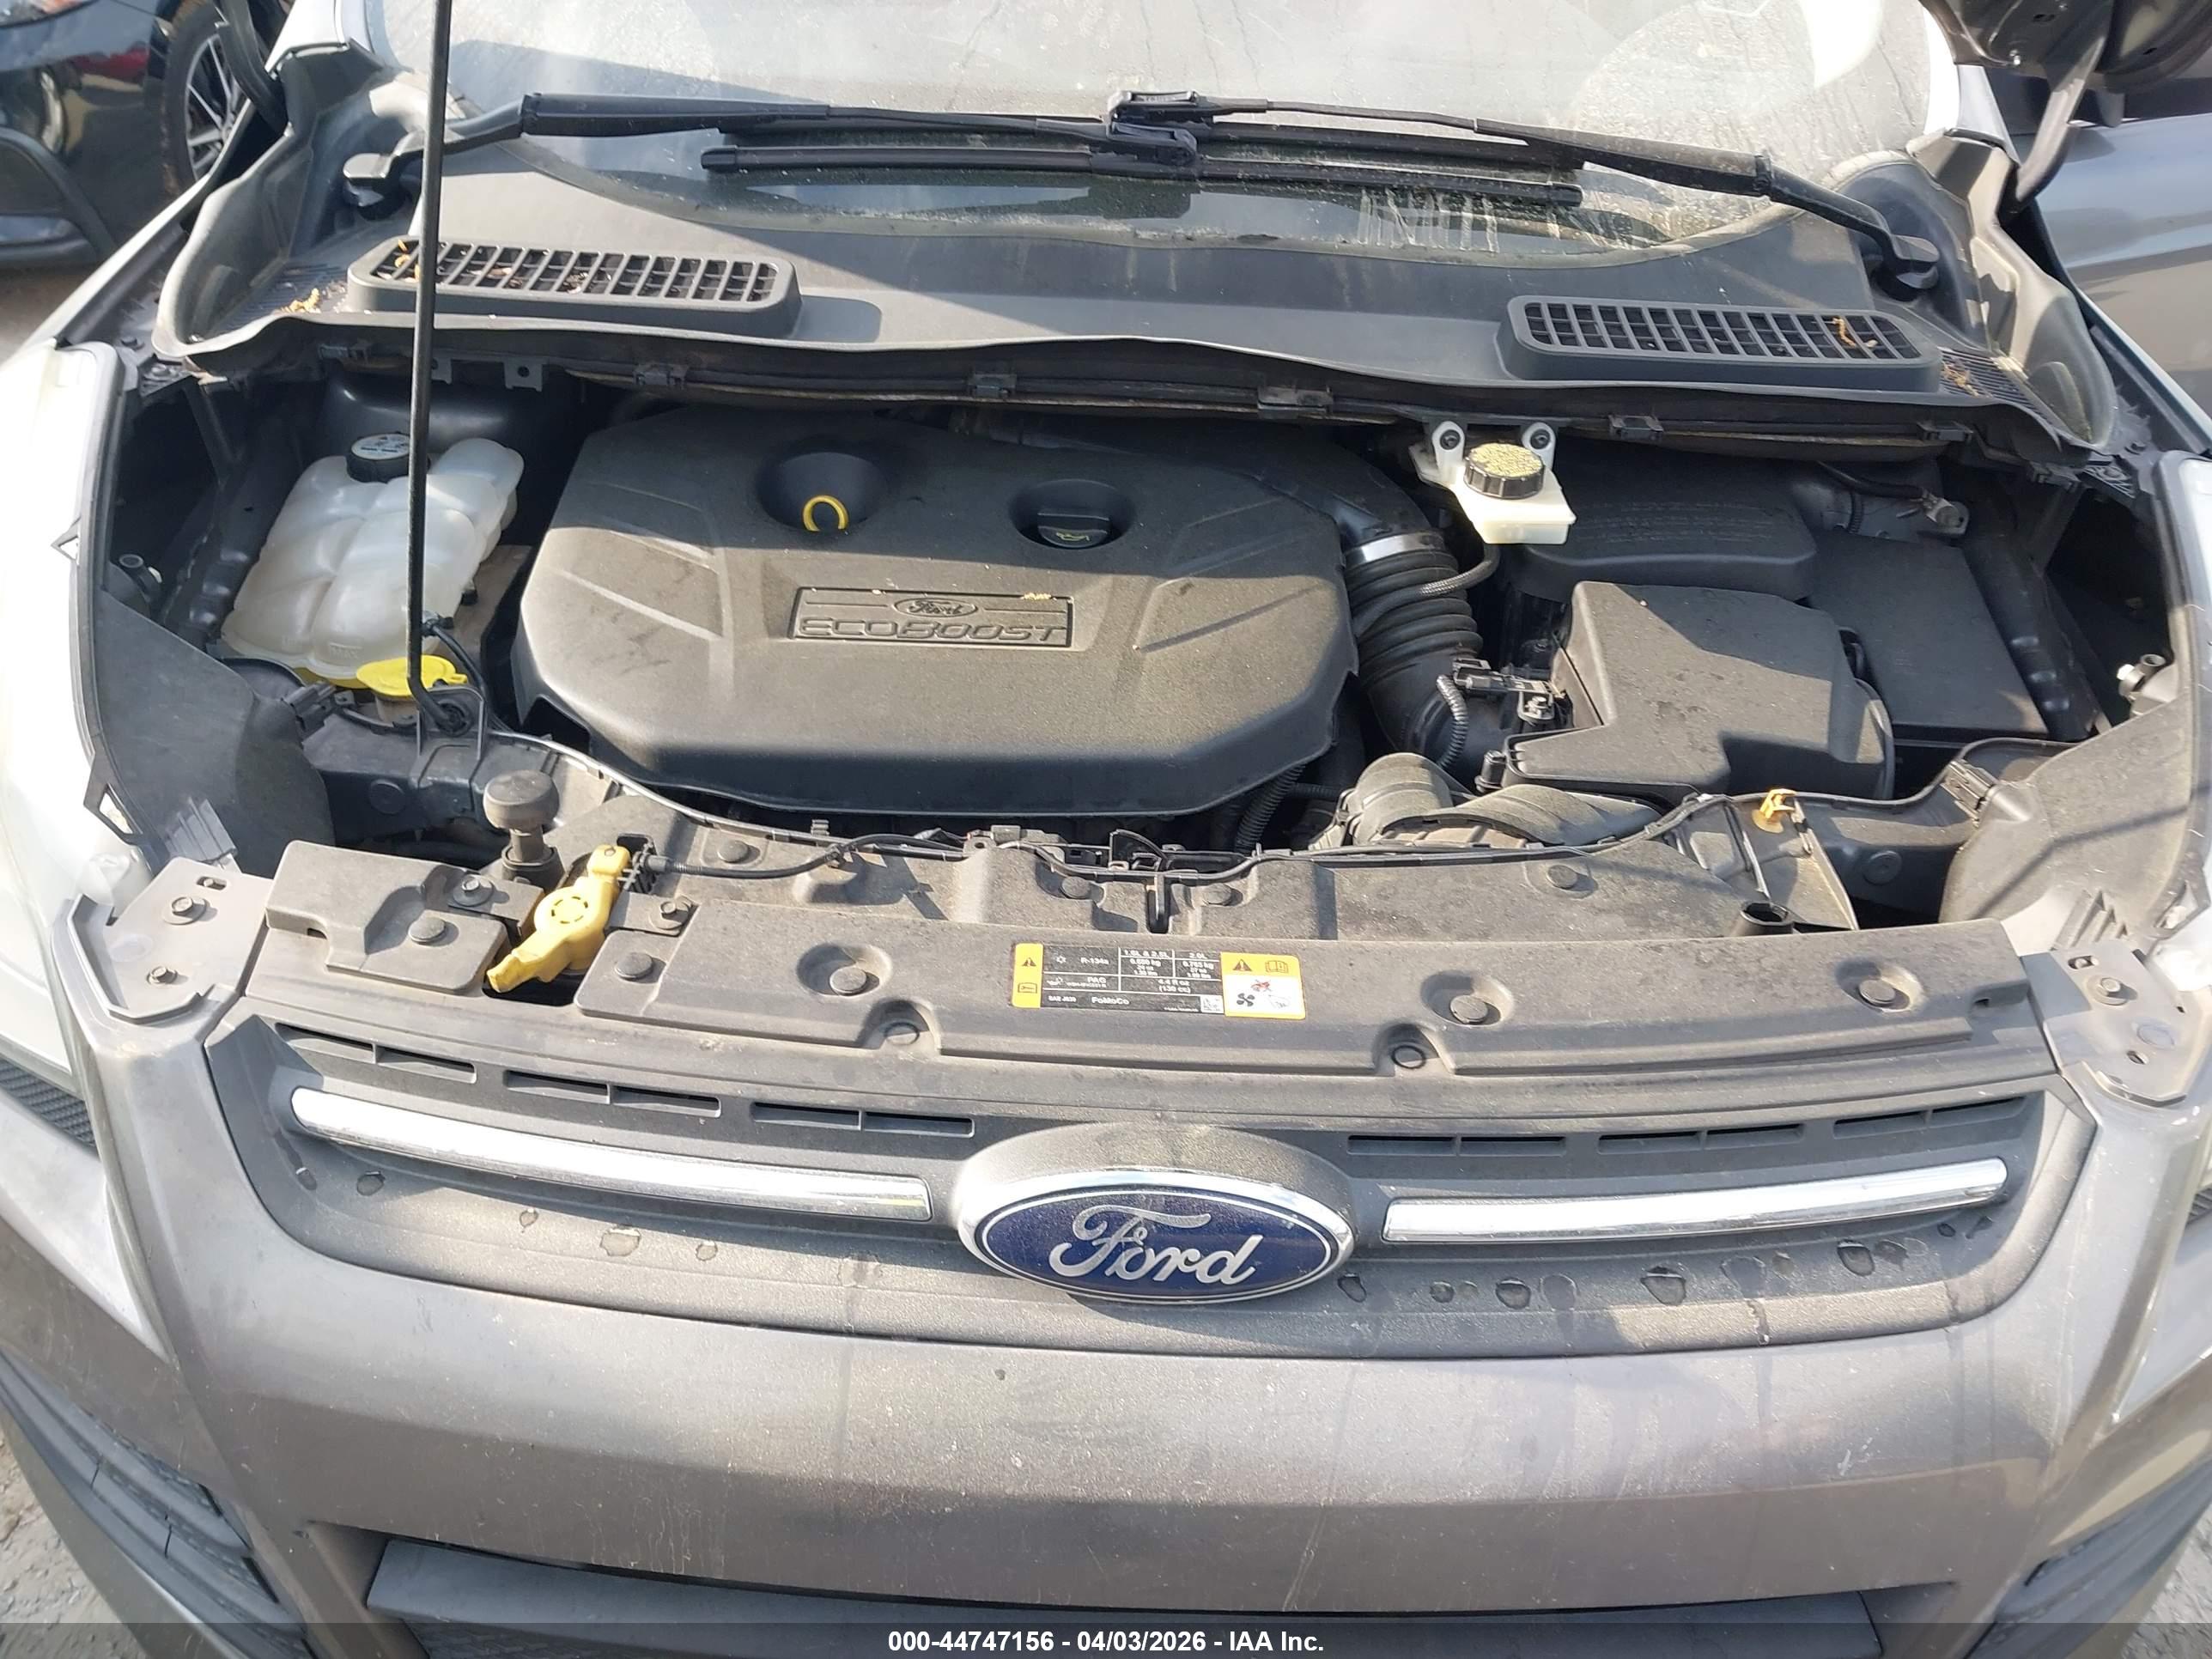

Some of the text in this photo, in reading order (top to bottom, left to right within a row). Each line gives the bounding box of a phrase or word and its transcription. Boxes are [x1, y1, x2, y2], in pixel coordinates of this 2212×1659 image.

[908, 598, 963, 616] Ford
[798, 616, 1067, 641] ECOBOOST
[1080, 957, 1109, 965] R-134a
[1091, 996, 1130, 1005] FoMoCo
[1049, 1204, 1263, 1285] Ford
